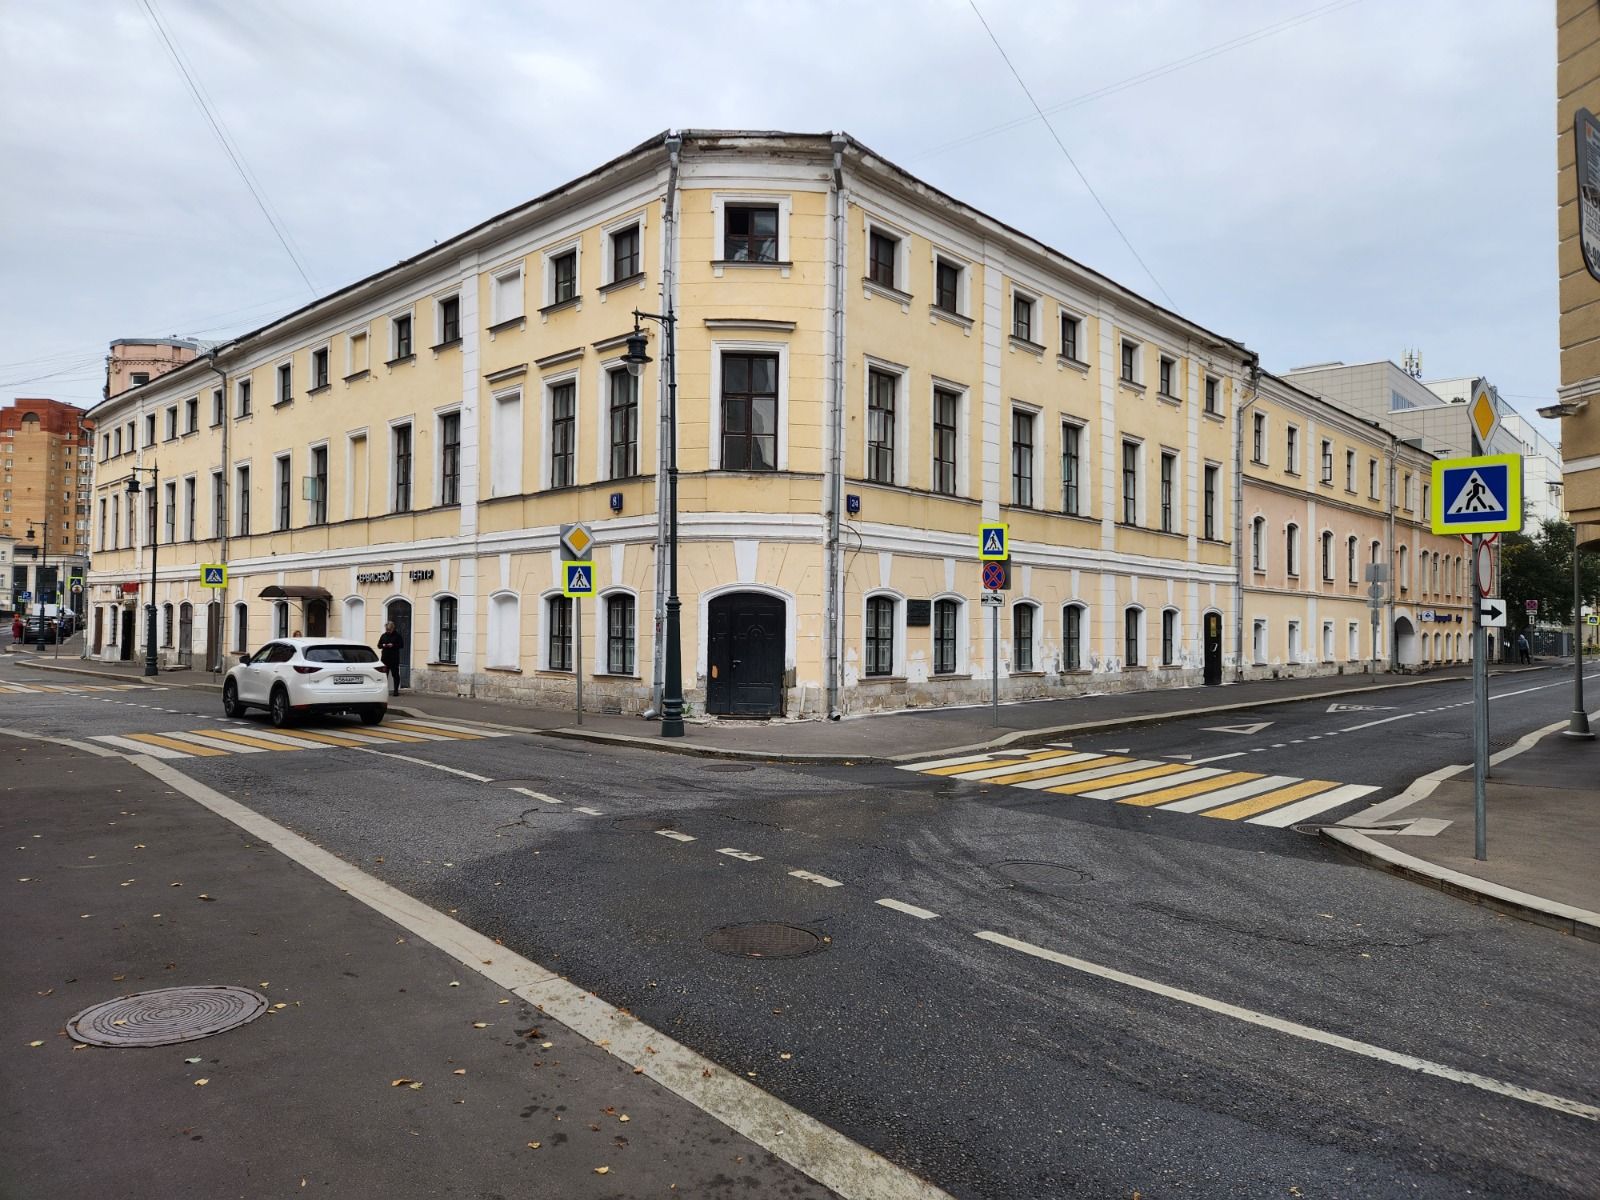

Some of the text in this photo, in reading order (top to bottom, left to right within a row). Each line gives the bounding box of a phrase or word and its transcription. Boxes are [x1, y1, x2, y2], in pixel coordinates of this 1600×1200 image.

[851, 499, 859, 508] 24
[356, 569, 434, 583] СЕРВИСНЫЙ ЦЕНТР
